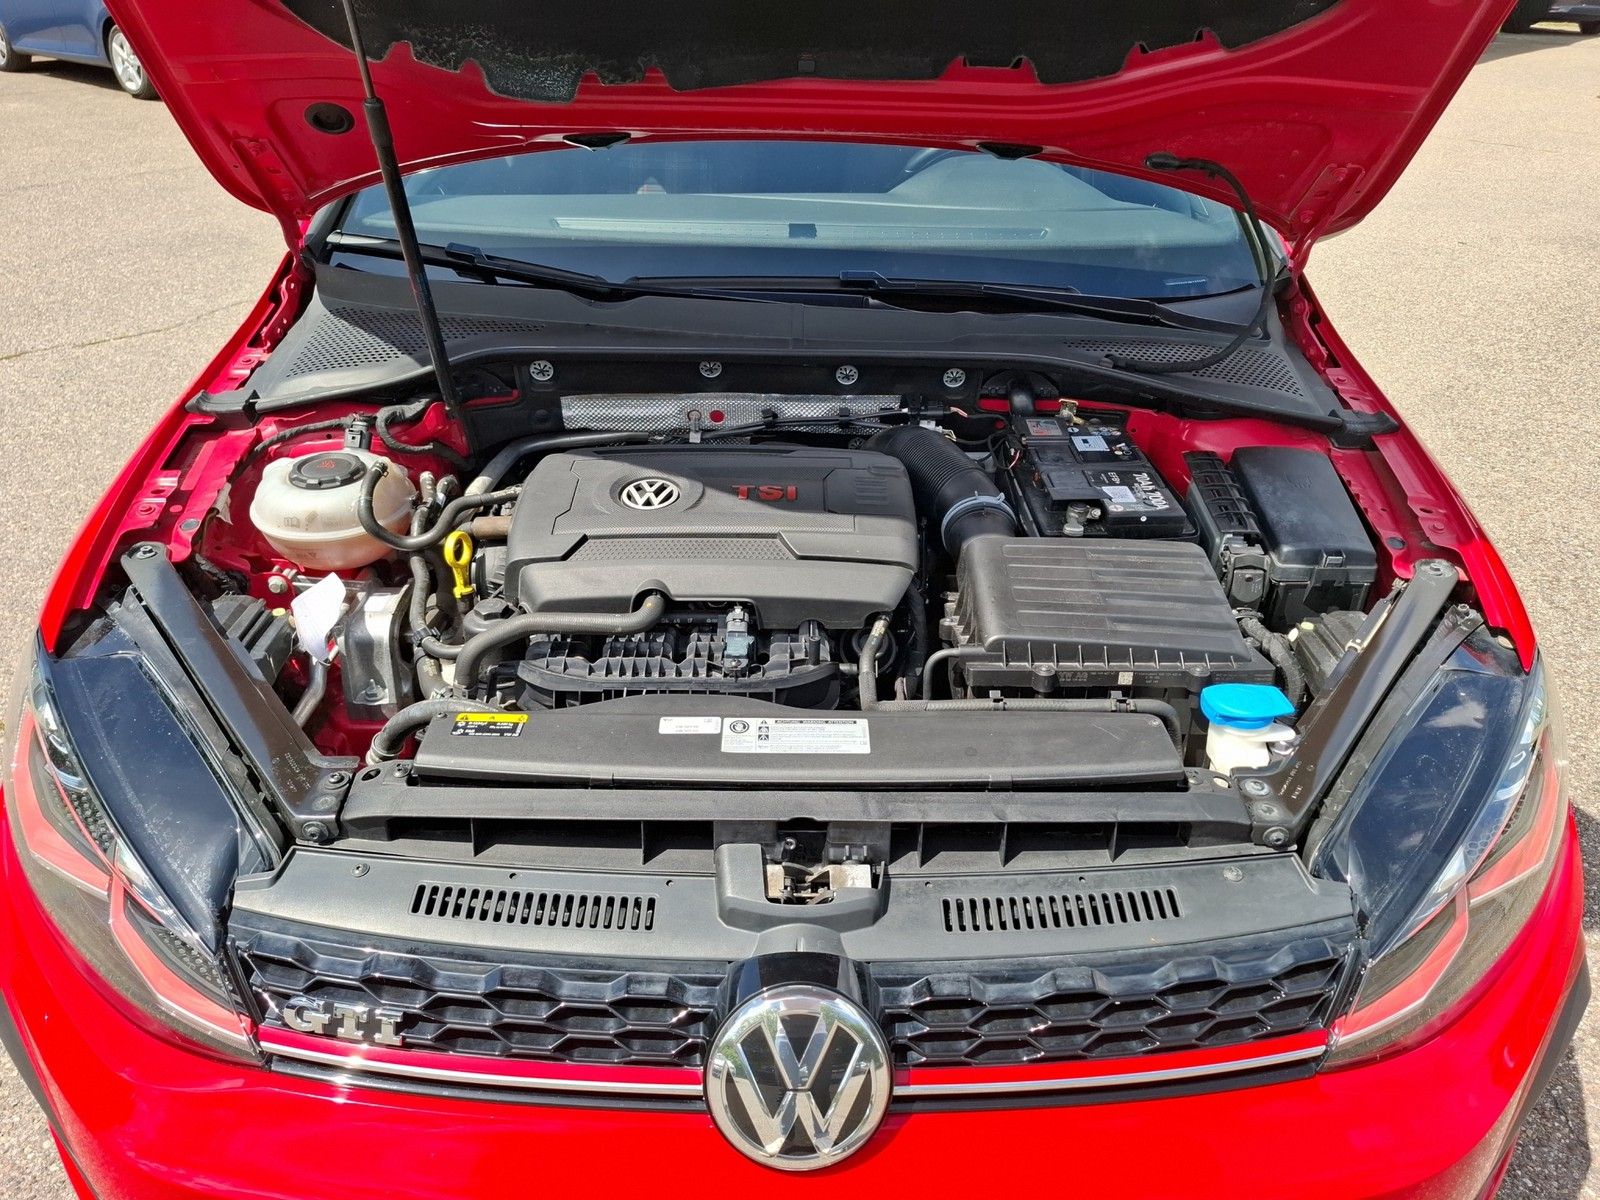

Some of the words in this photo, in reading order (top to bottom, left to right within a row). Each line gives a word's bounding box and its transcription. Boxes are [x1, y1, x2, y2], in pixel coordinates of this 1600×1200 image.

[622, 479, 680, 510] VW
[732, 485, 798, 501] TSI
[283, 996, 404, 1046] GTI
[708, 986, 890, 1168] VW
